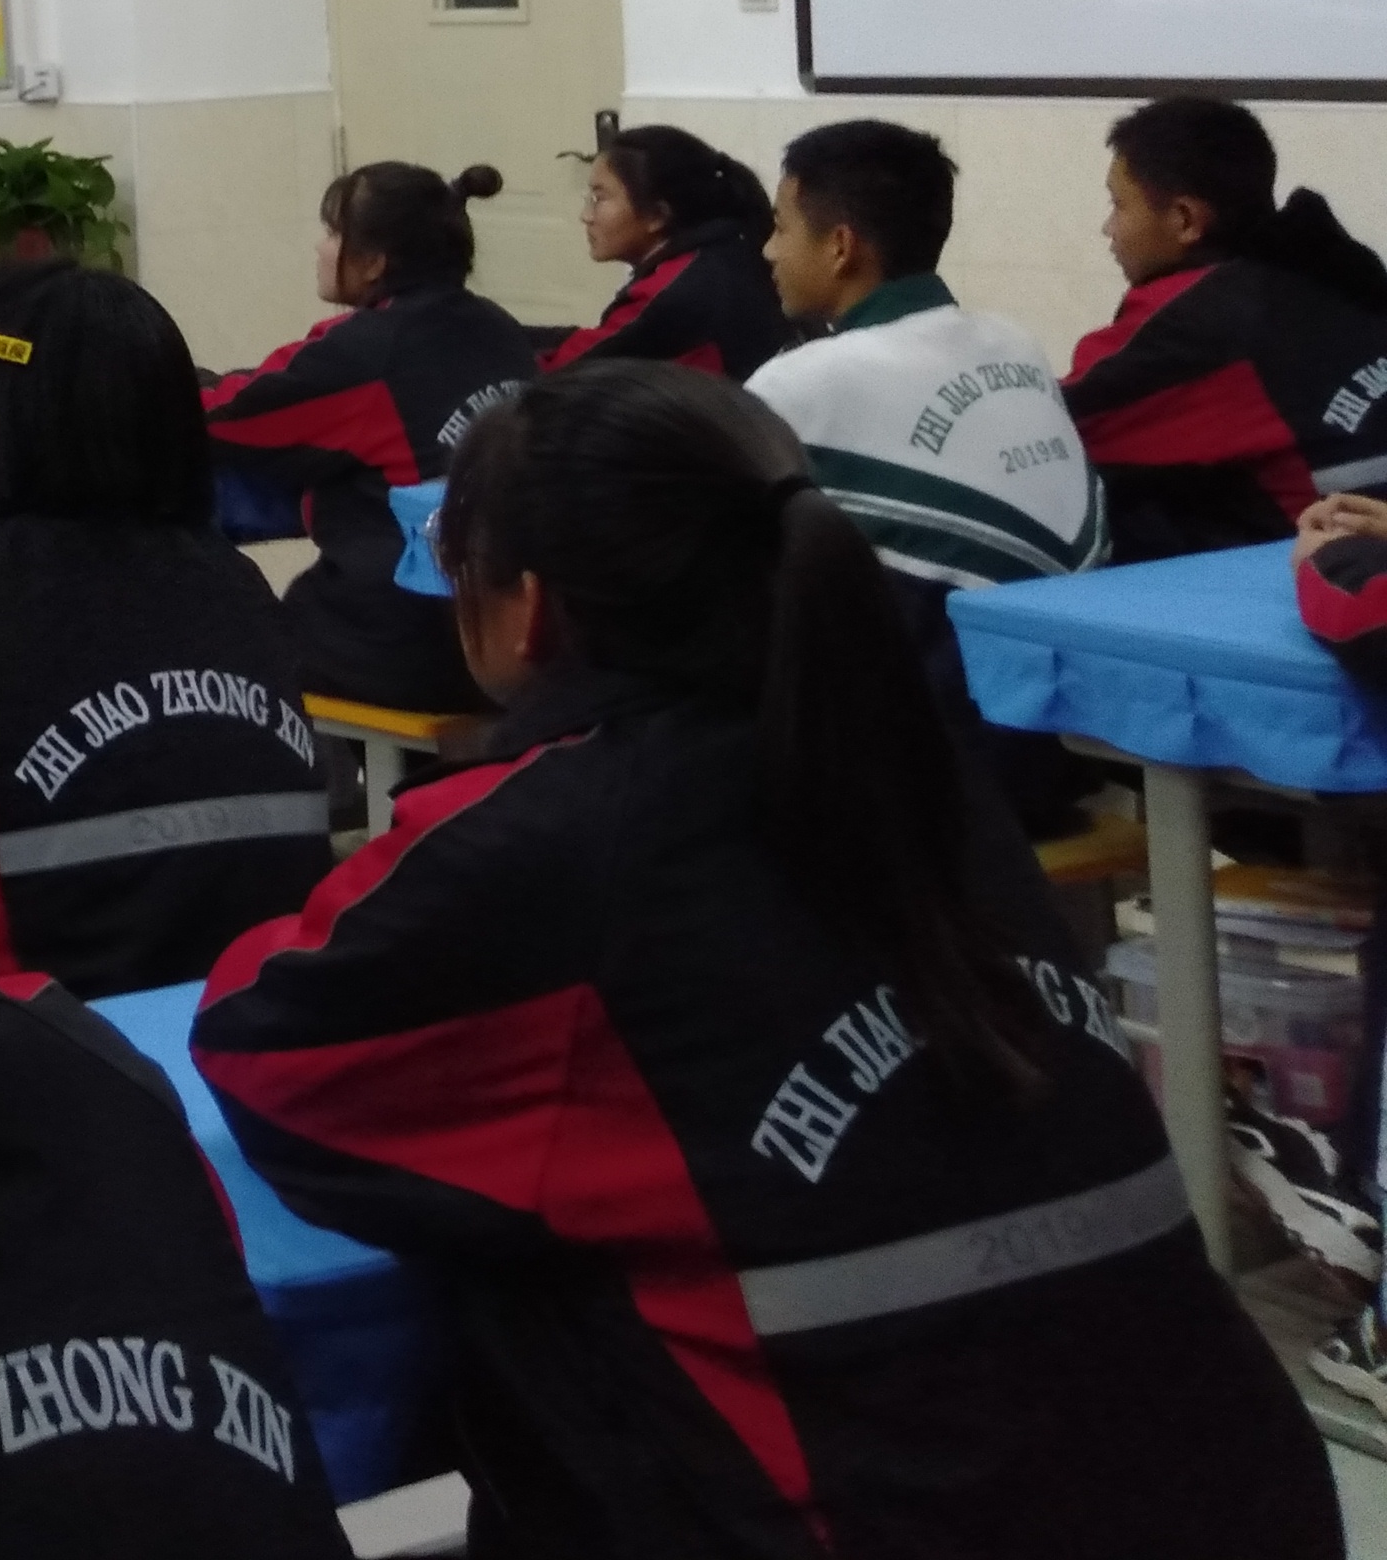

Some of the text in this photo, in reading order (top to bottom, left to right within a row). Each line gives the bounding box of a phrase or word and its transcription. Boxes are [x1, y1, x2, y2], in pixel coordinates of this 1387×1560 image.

[904, 405, 954, 457] ZHI
[937, 372, 984, 416] JIAO
[1322, 386, 1372, 434] ZHI
[14, 725, 86, 802] ZHI
[70, 682, 150, 747] JIAO
[150, 669, 268, 725] ZHONG
[750, 1061, 859, 1185] ZHI
[207, 1354, 296, 1484] XIN
